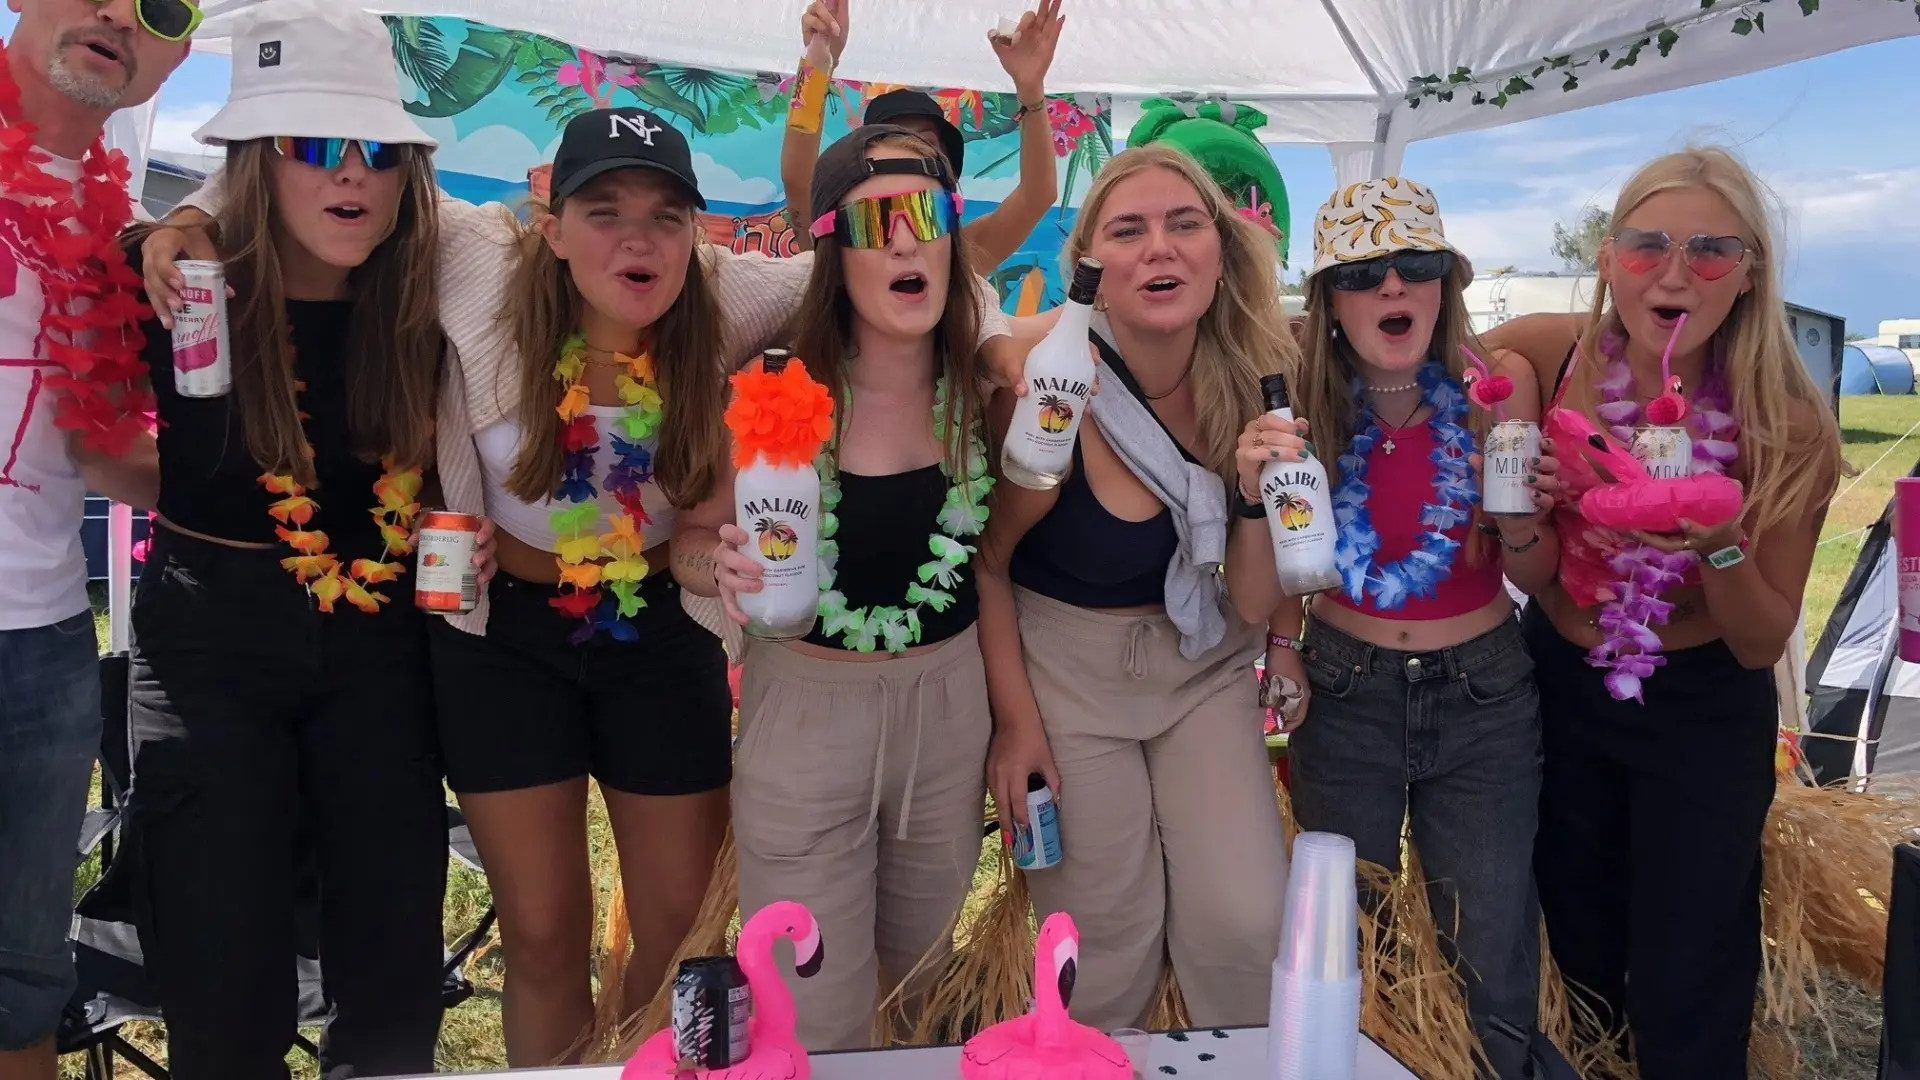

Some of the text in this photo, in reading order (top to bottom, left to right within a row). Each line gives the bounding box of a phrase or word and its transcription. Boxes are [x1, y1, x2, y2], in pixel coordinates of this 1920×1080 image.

[609, 115, 663, 147] NY
[178, 288, 208, 301] NOFF
[173, 315, 205, 323] PBERRY
[1033, 377, 1090, 401] MALIBU
[1495, 457, 1529, 475] MOK
[1263, 471, 1321, 500] MALIBU
[744, 497, 812, 520] MALIBU
